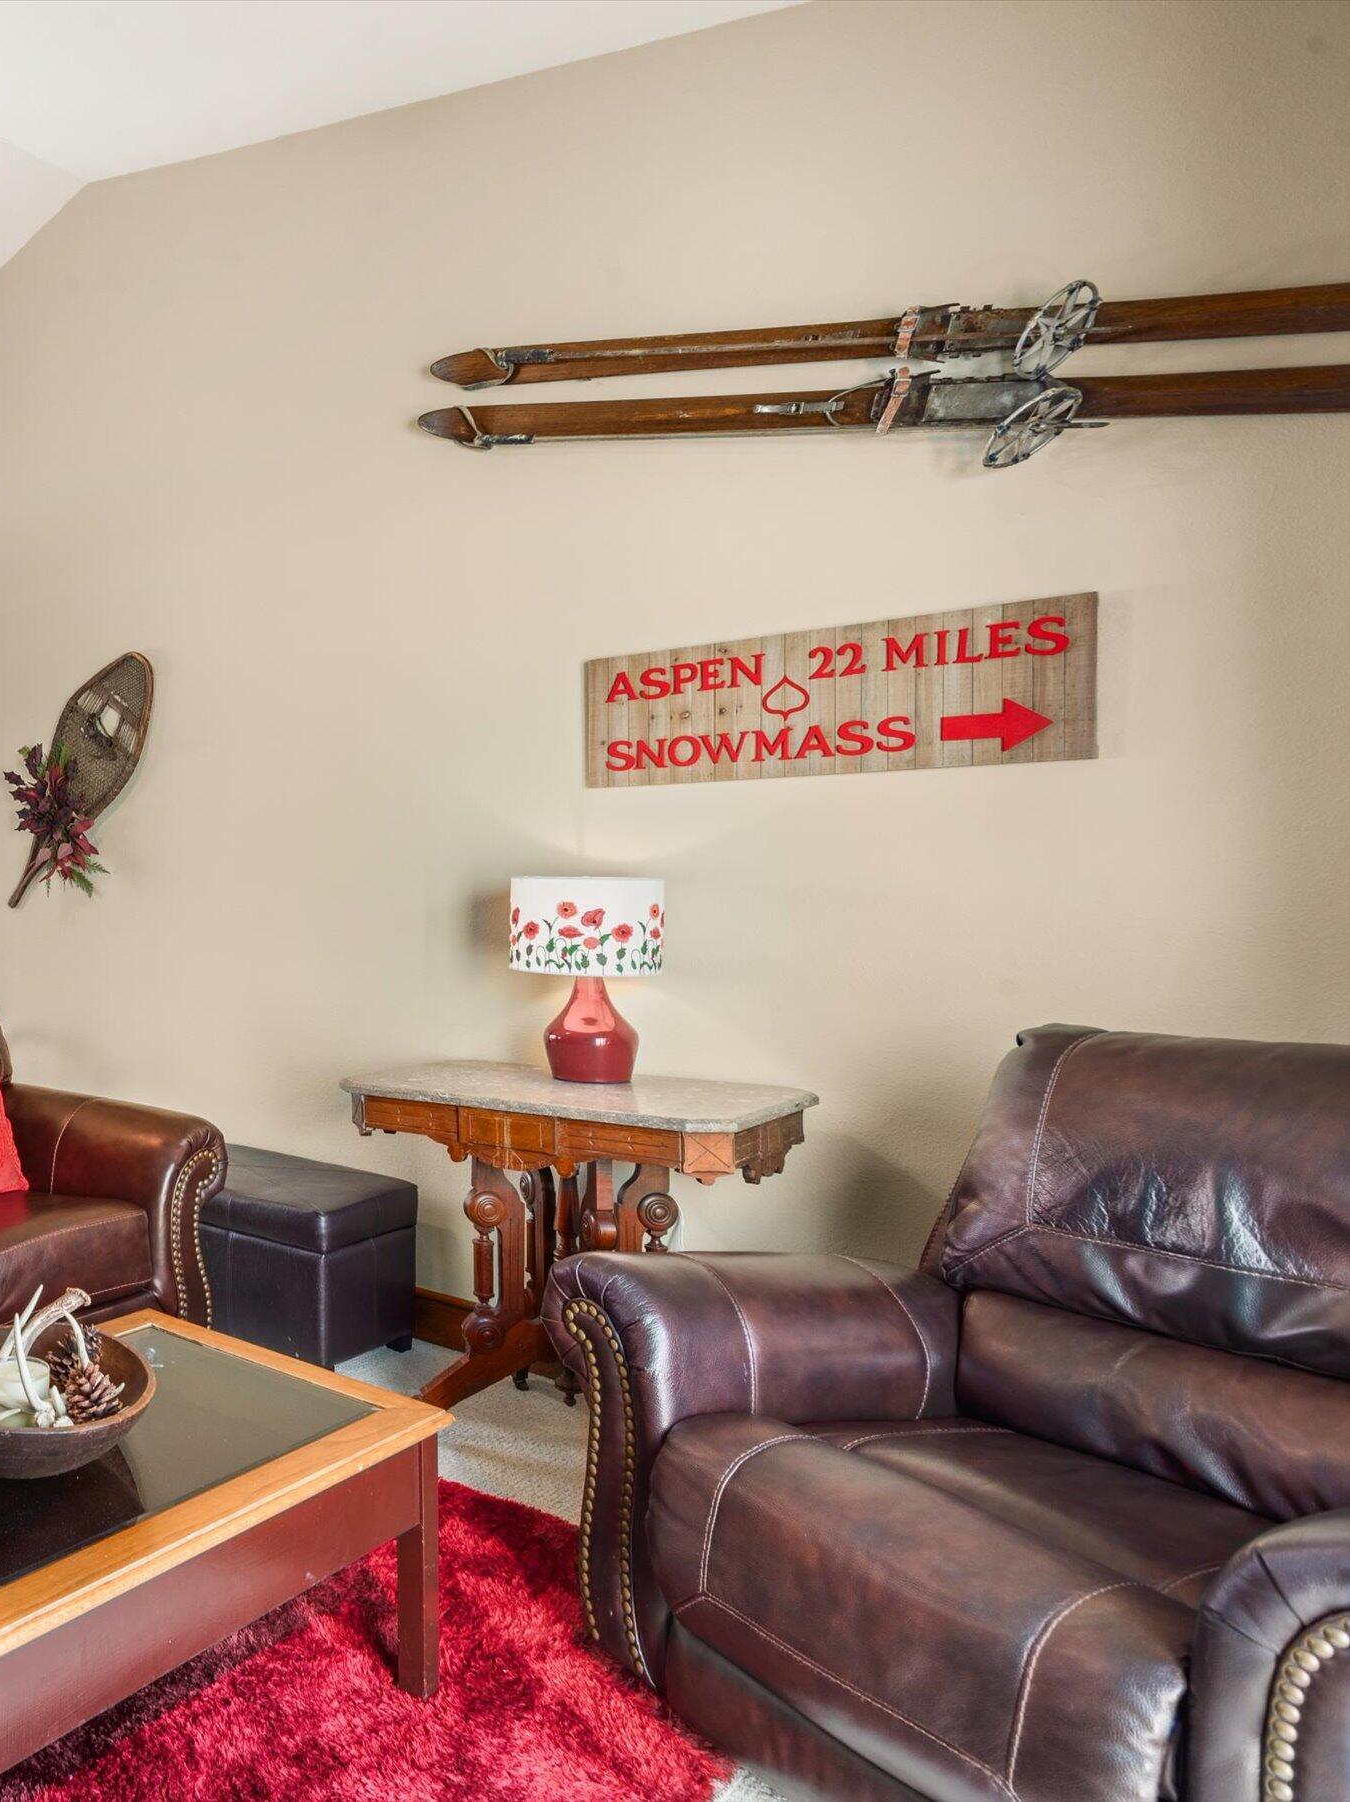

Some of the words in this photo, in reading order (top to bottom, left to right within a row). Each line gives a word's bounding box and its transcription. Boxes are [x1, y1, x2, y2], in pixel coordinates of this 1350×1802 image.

[605, 654, 766, 704] ASPEN
[808, 642, 867, 681] 22
[881, 614, 1071, 672] MILES
[605, 716, 917, 772] SNOWMASS
